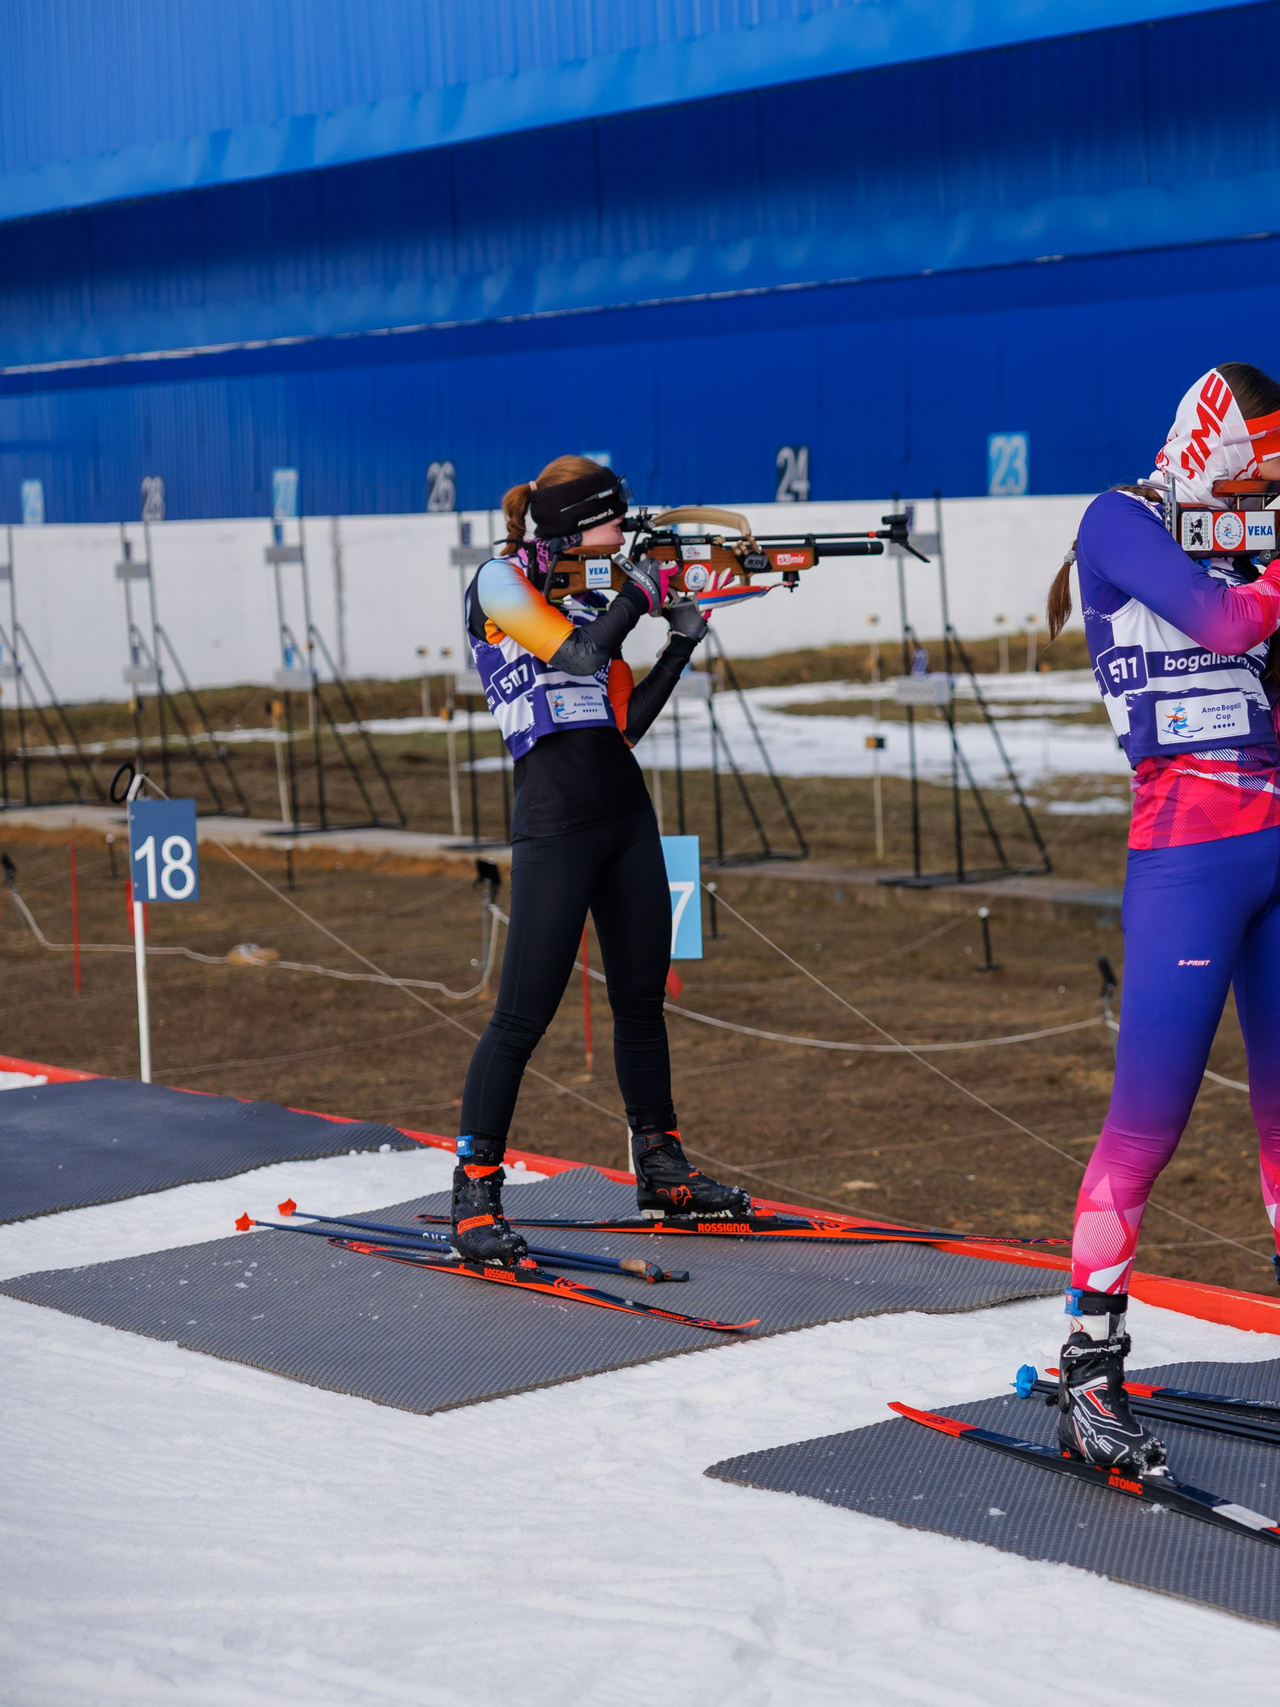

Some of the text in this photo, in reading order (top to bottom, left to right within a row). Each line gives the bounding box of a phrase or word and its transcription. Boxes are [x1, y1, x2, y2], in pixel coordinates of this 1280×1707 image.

[776, 446, 810, 501] 24
[989, 434, 1027, 496] 23
[427, 462, 455, 511] 26
[578, 511, 608, 527] FISCHER
[1248, 526, 1273, 536] VEKA
[589, 567, 609, 575] VEKA
[134, 835, 196, 900] 18
[668, 881, 695, 955] 7
[697, 1223, 752, 1232] ROSSIGNOL
[483, 1267, 517, 1282] ROSSIGNOL
[1072, 1405, 1114, 1455] SPINE
[1108, 1475, 1143, 1495] ATOMIC
